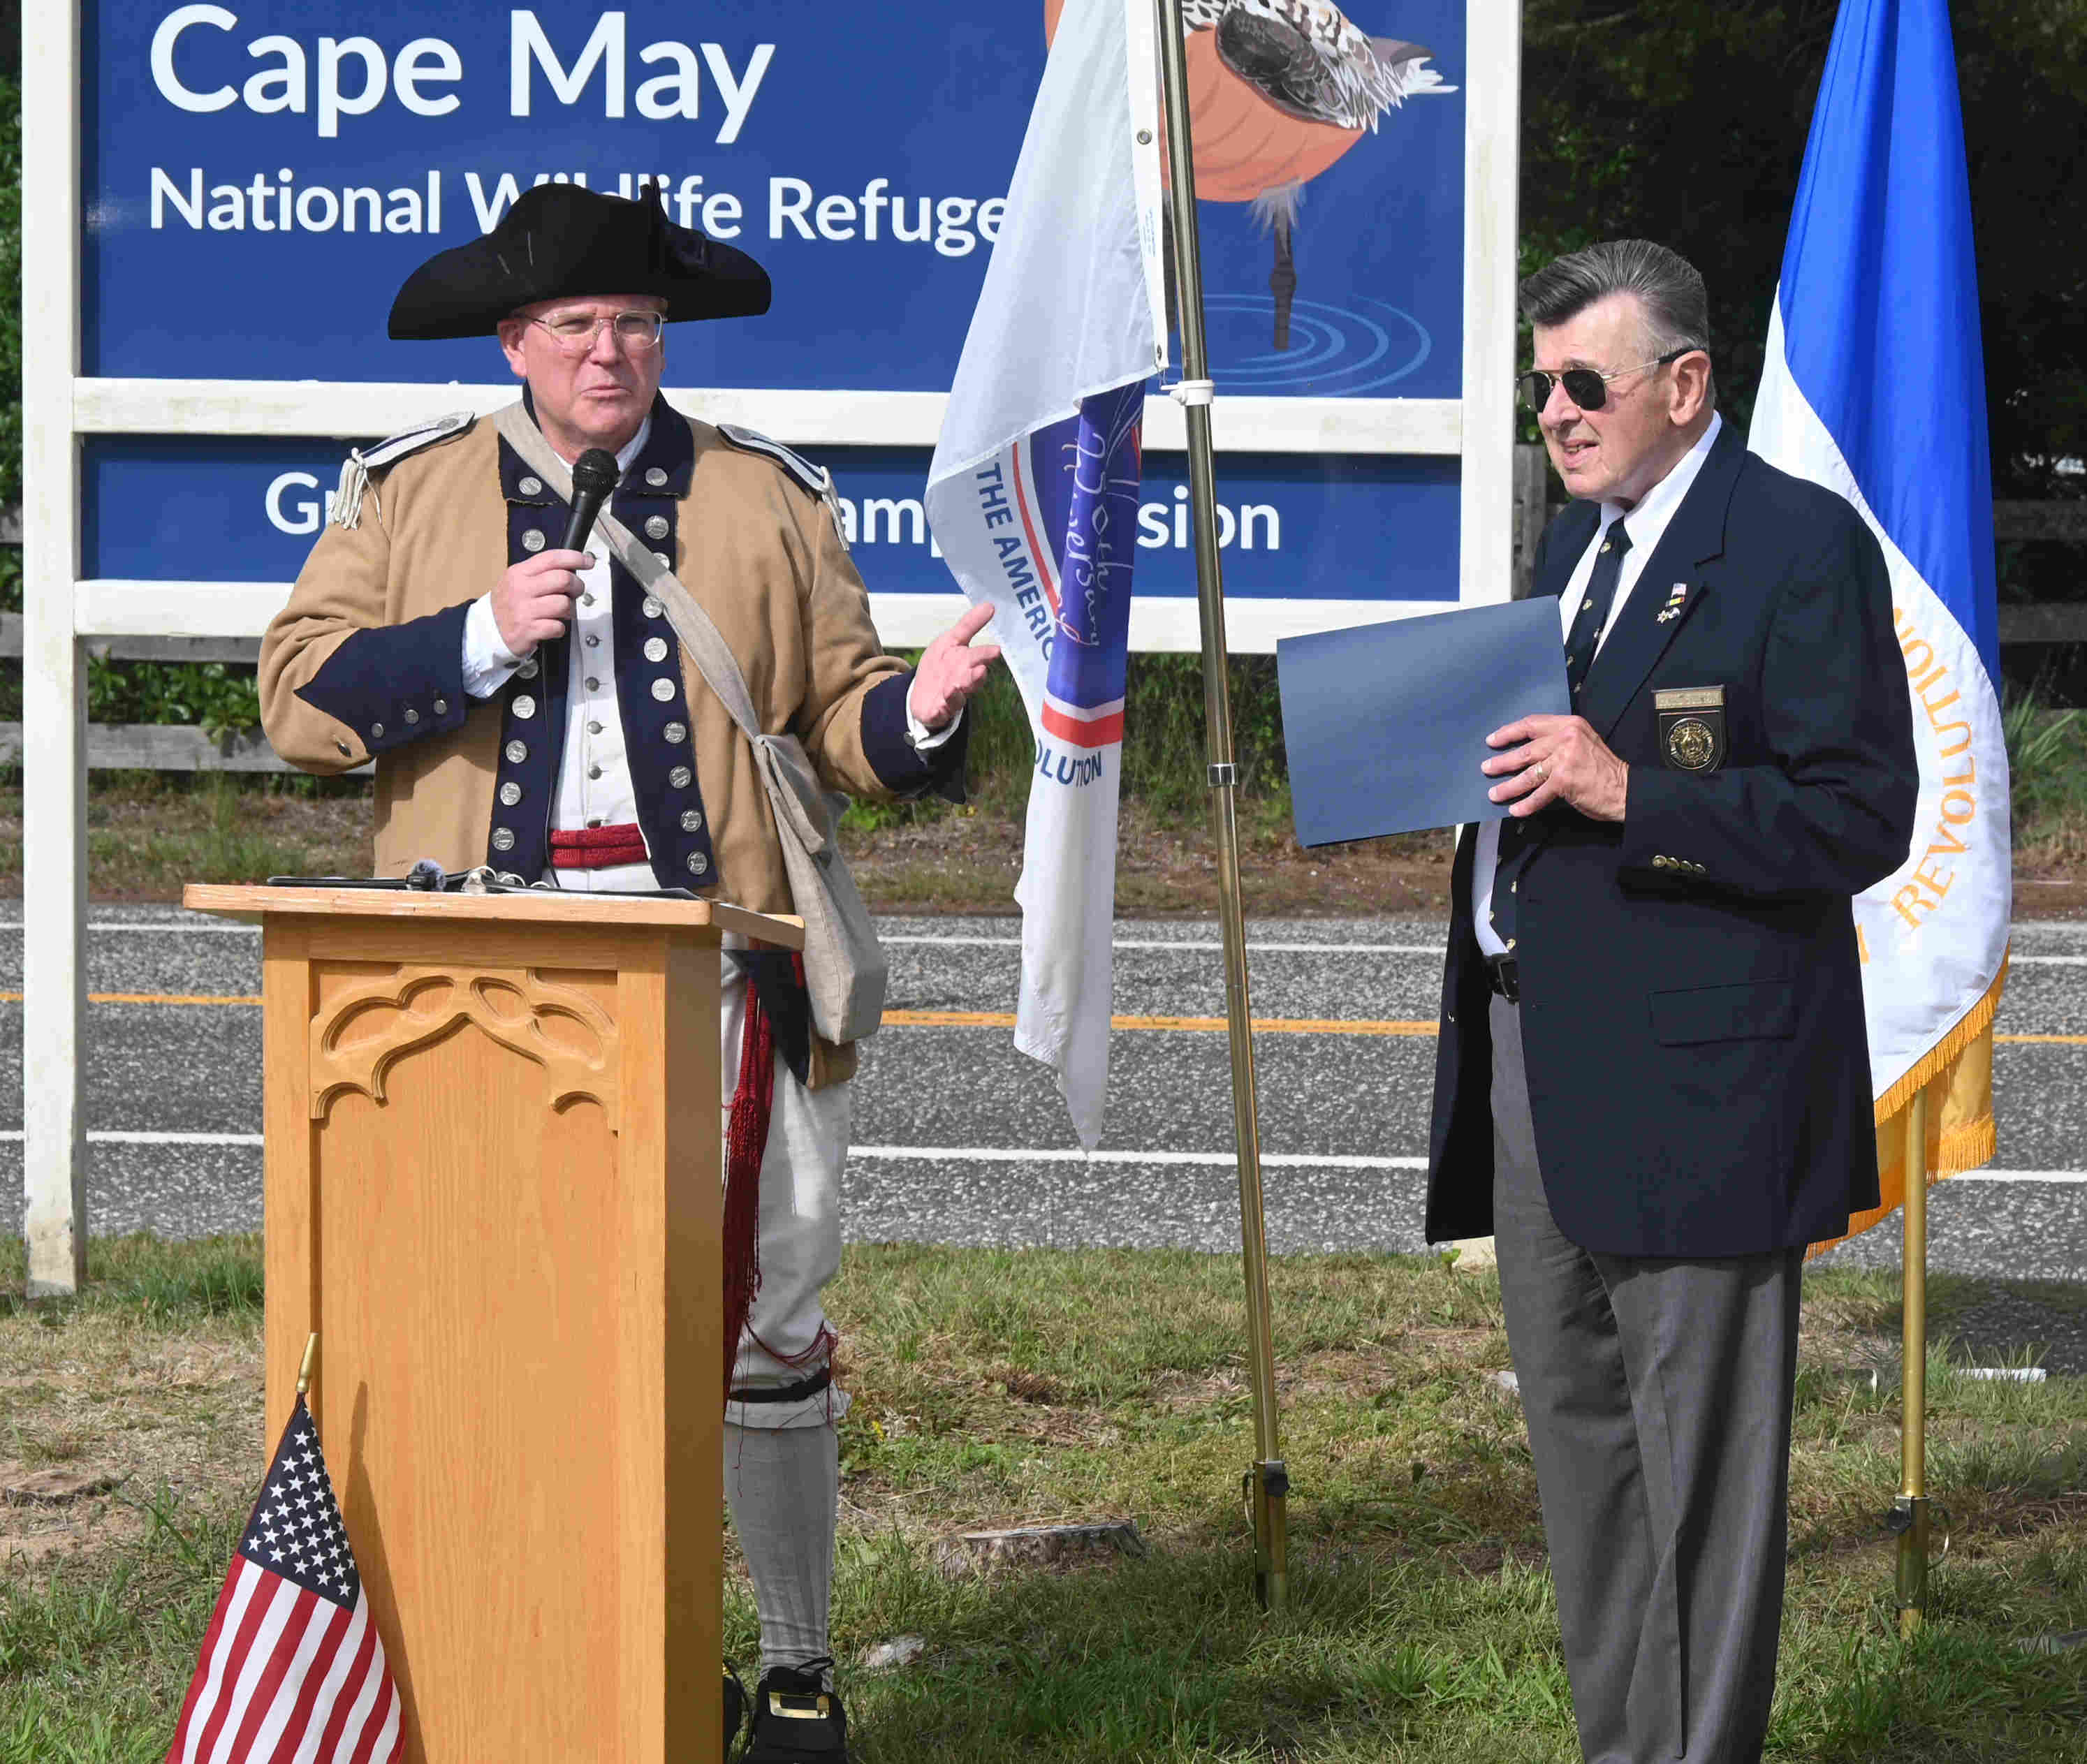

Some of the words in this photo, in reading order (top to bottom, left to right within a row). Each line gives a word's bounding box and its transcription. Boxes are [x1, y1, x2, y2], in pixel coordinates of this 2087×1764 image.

[150, 4, 462, 138] Cape
[511, 10, 775, 144] May
[151, 168, 440, 235] National
[976, 462, 1013, 530] THE
[993, 537, 1055, 661] AMERIC
